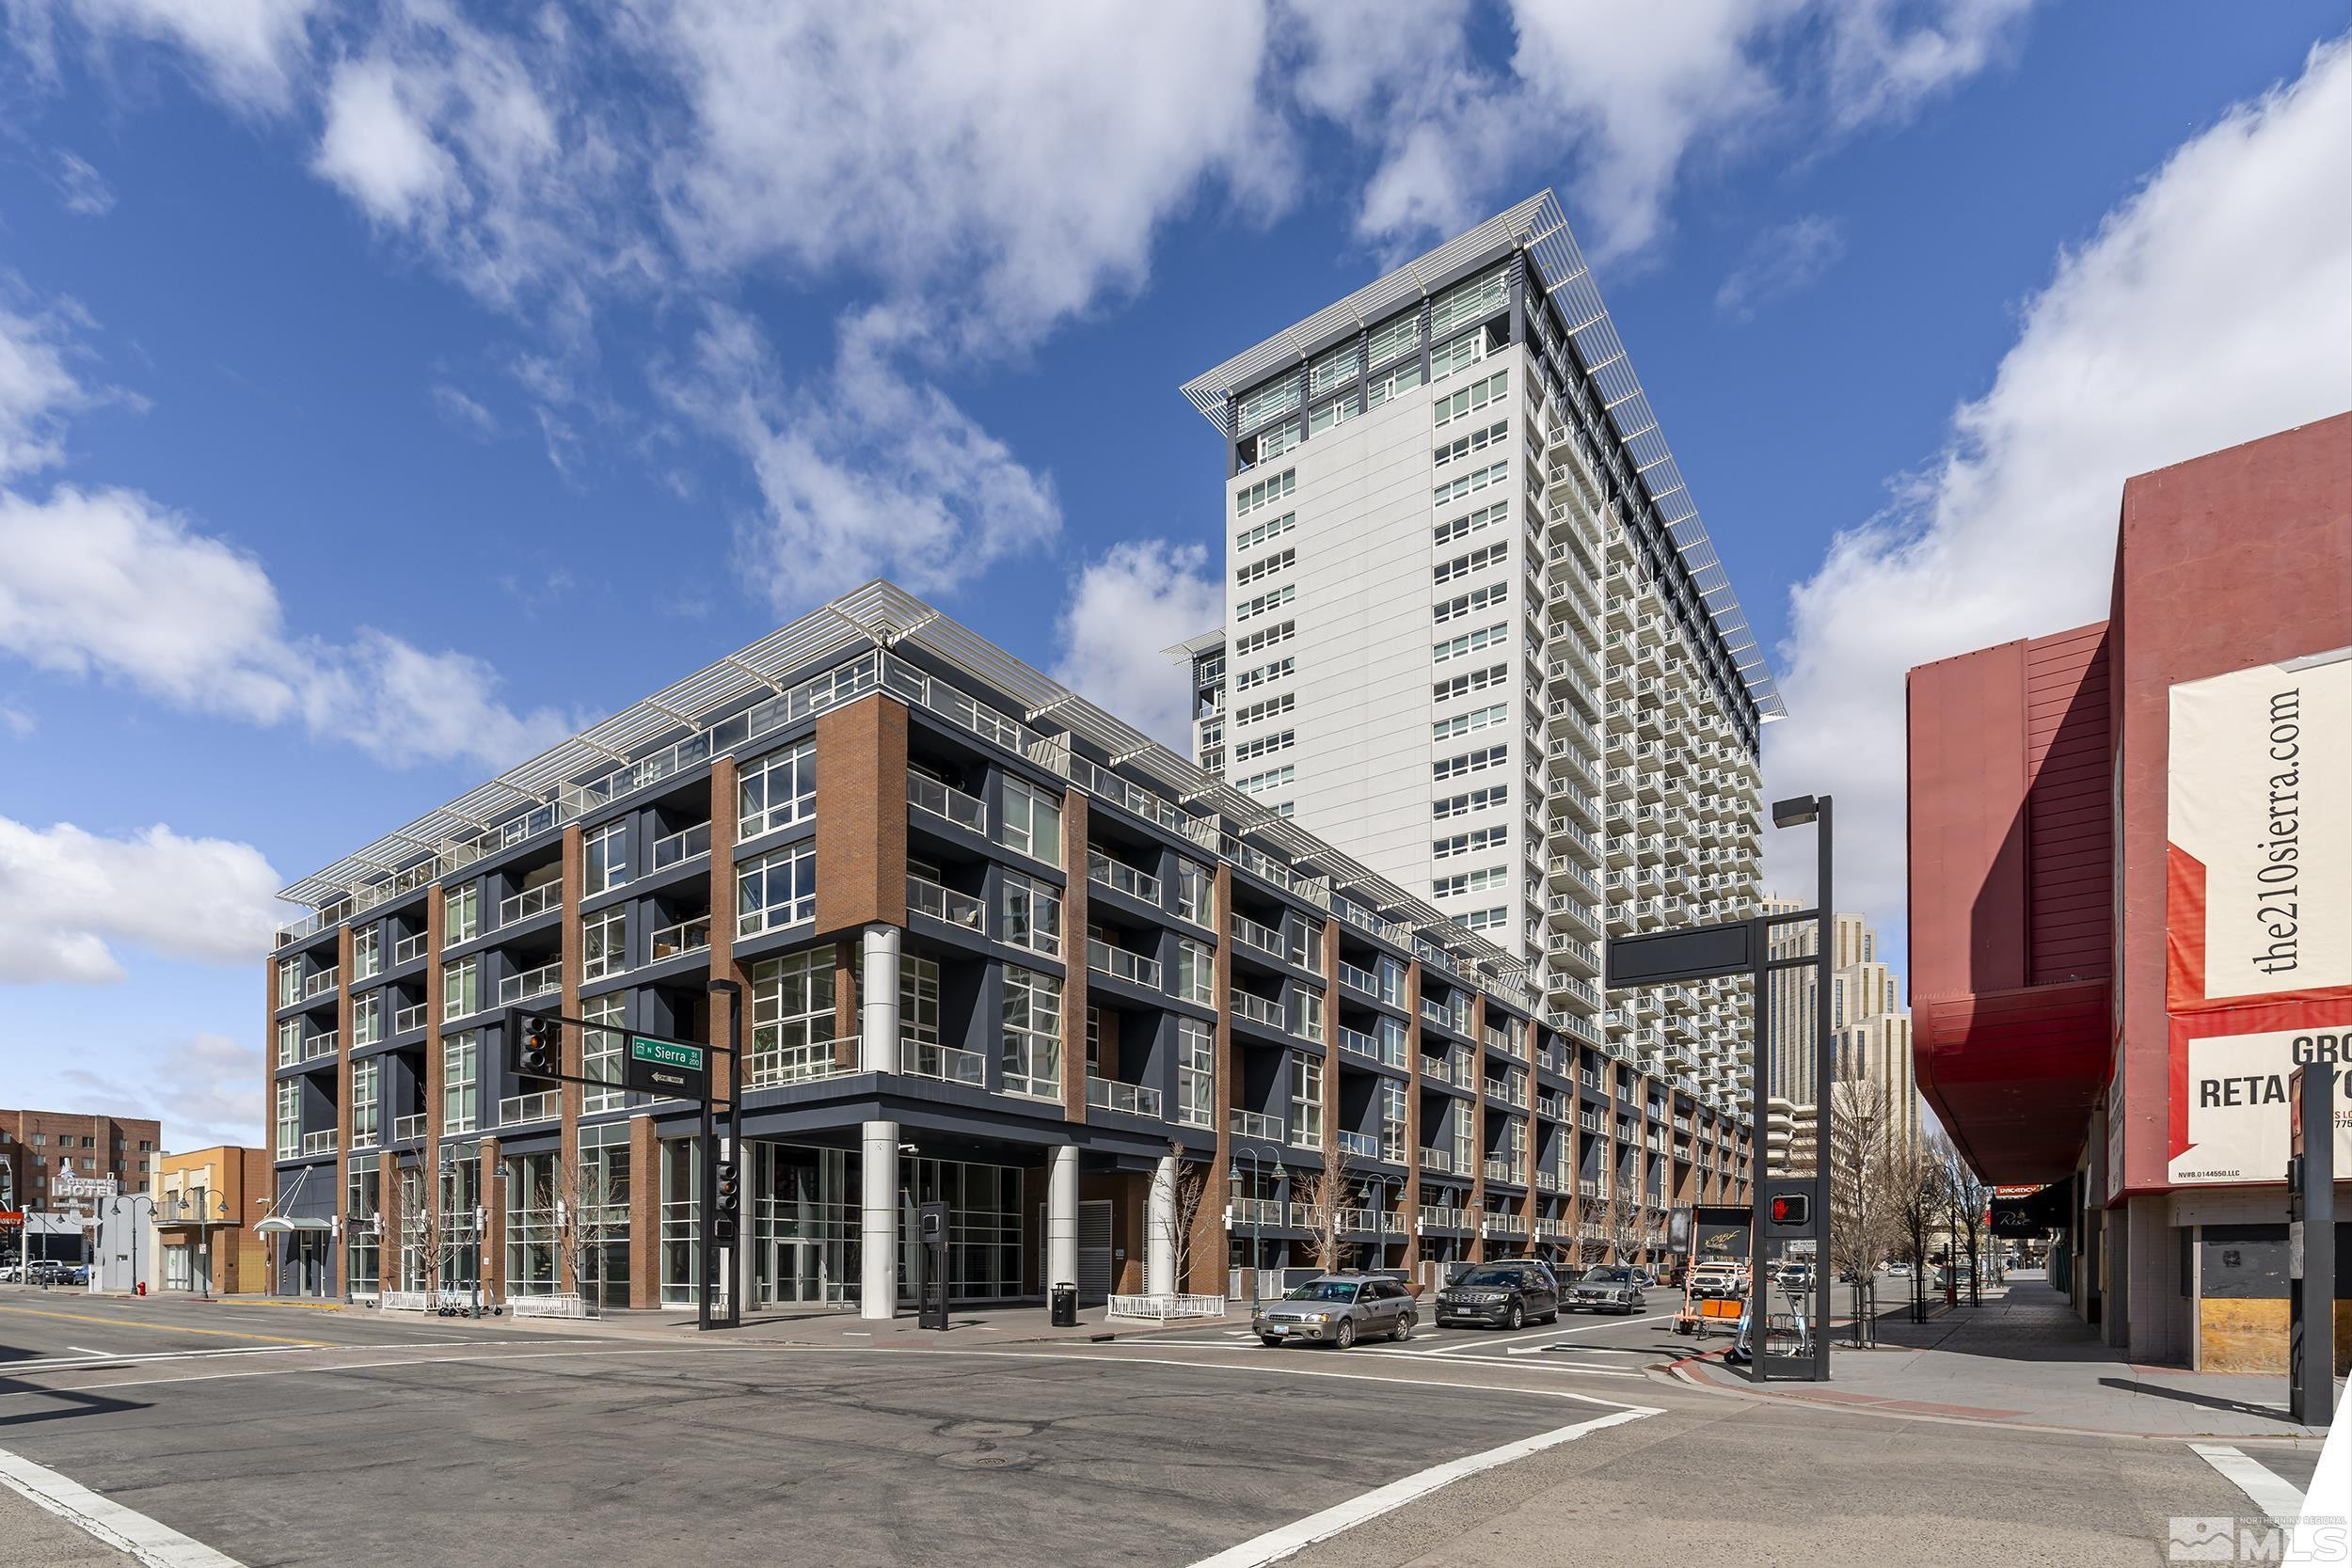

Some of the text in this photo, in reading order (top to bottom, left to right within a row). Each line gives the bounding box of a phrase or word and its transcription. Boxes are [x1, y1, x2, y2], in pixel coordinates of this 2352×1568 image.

[2252, 688, 2299, 974] the210sierra.com
[655, 1046, 686, 1063] Sierra
[689, 1058, 700, 1067] 200
[2201, 1074, 2292, 1108] RETA
[59, 1185, 117, 1196] HOTEL
